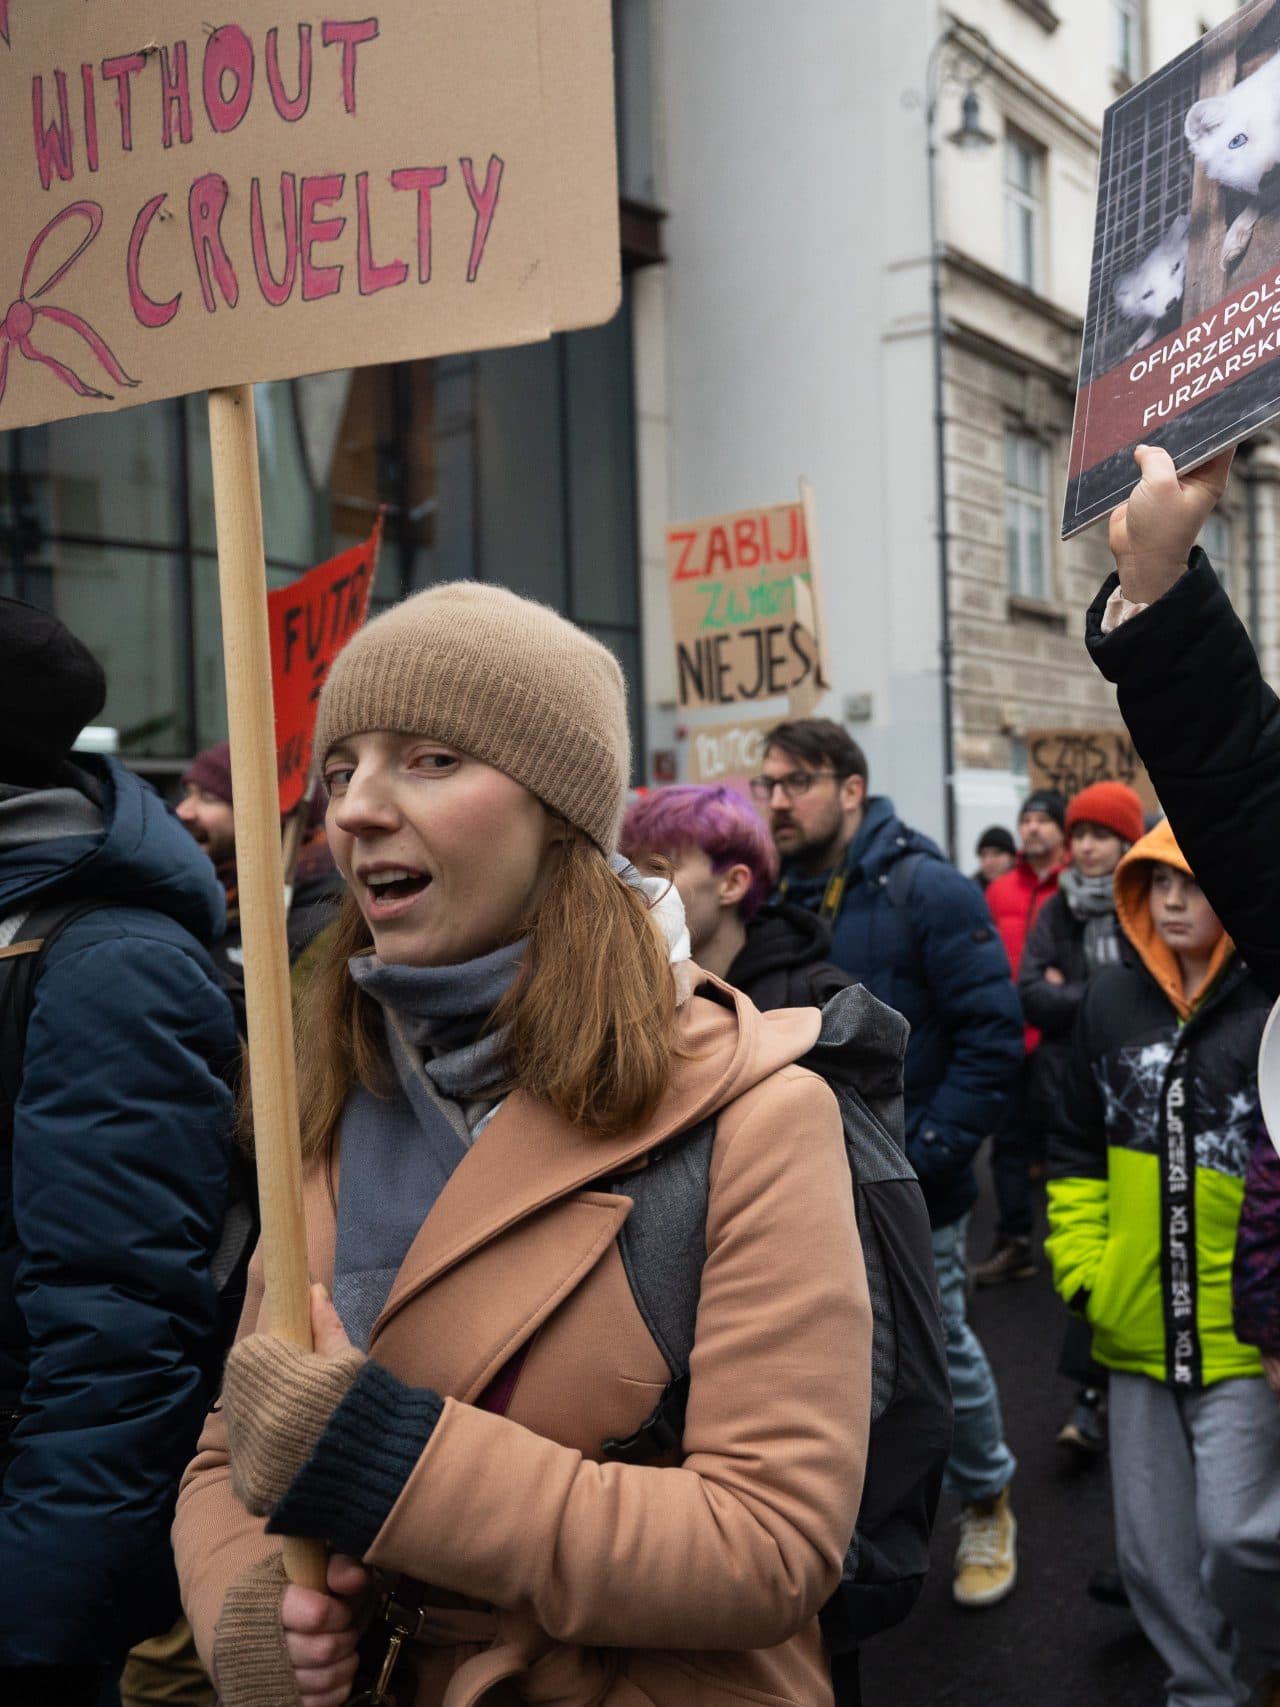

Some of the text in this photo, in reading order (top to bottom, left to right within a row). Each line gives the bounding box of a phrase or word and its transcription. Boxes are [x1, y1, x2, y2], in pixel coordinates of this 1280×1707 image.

[32, 18, 379, 190] WITHOUT
[127, 154, 504, 328] CRUELTY
[1129, 314, 1218, 382] OFIARY
